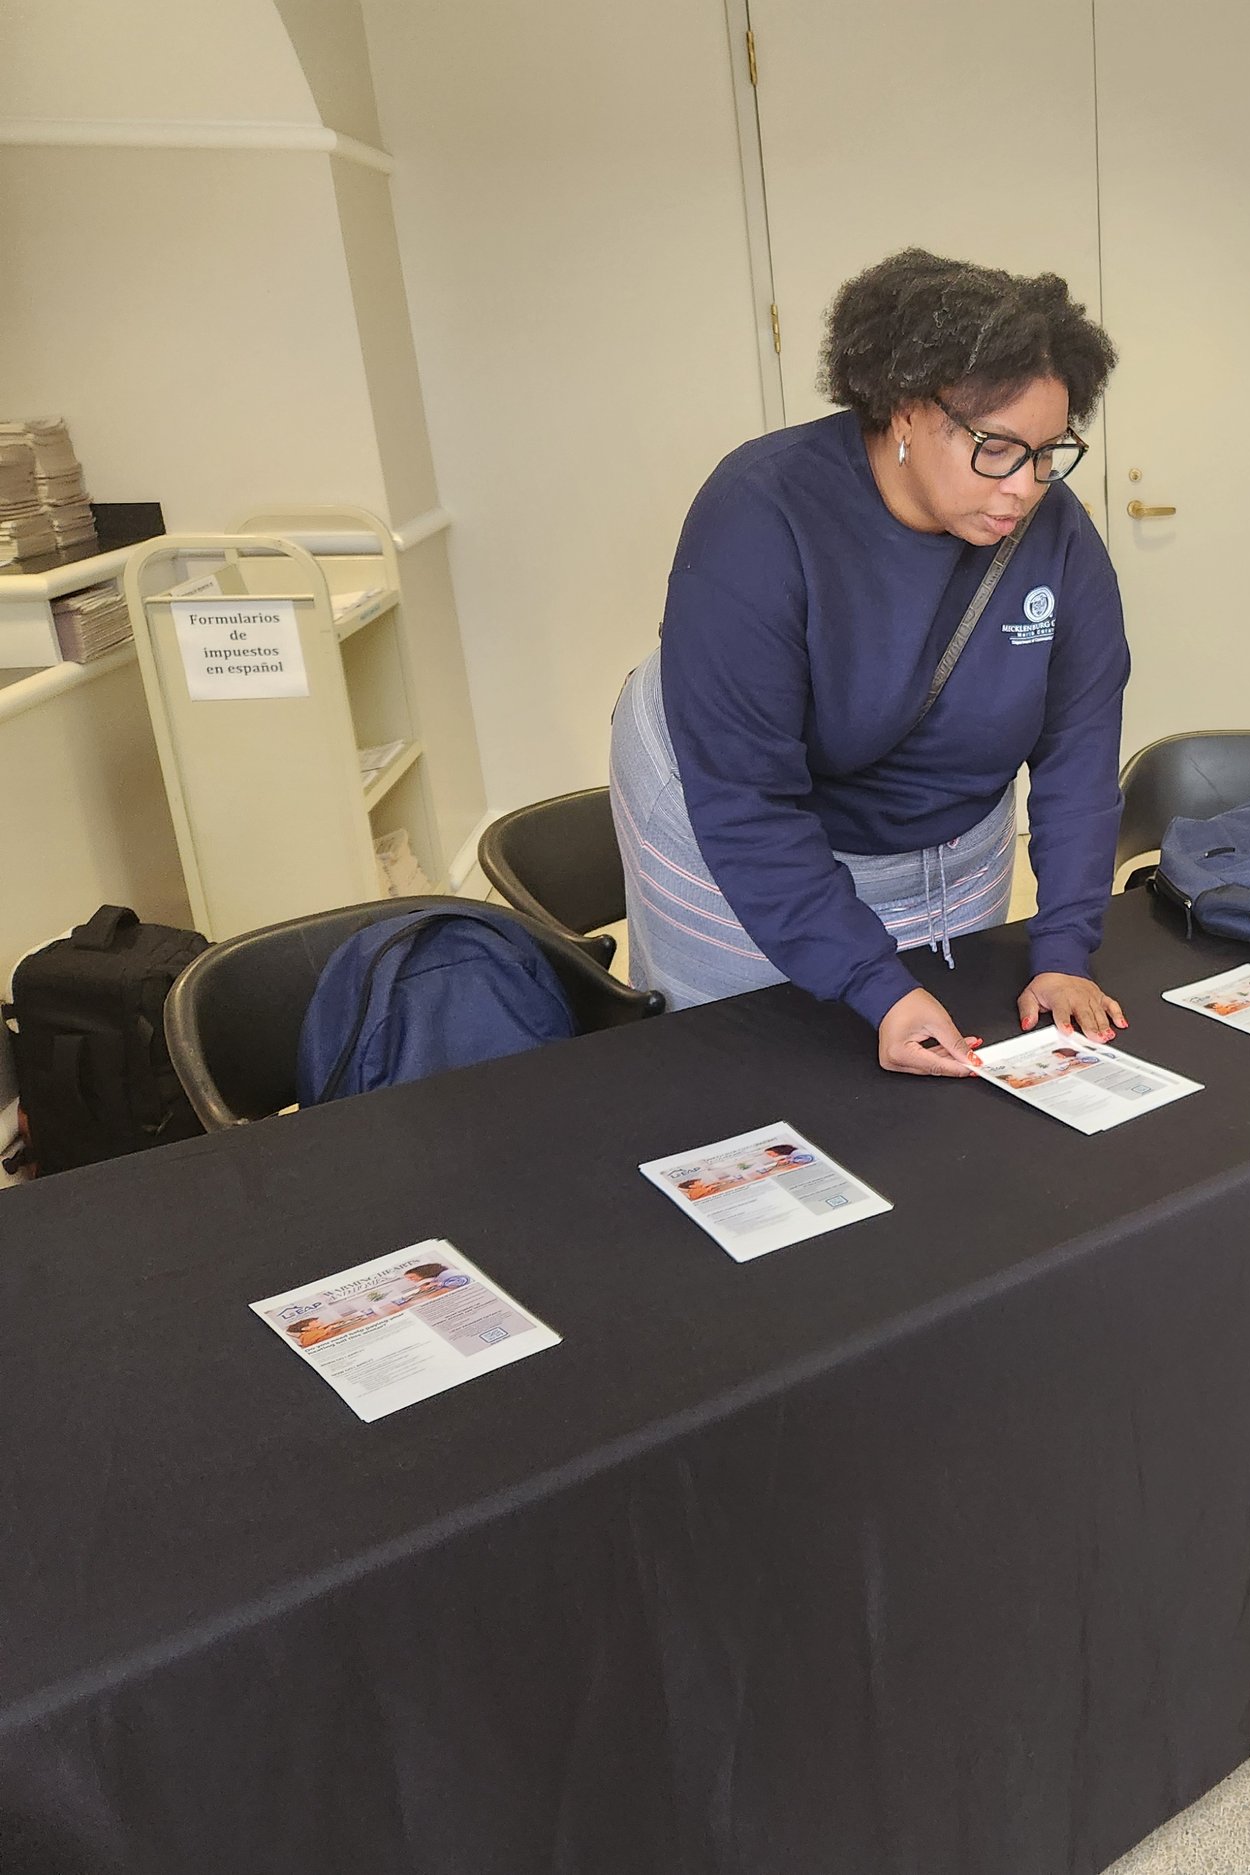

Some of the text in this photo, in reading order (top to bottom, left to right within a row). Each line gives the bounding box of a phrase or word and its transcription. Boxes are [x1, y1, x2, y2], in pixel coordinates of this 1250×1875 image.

[189, 612, 280, 626] Formularios
[229, 629, 247, 641] de
[204, 646, 280, 660] impuestos
[206, 661, 283, 676] en español
